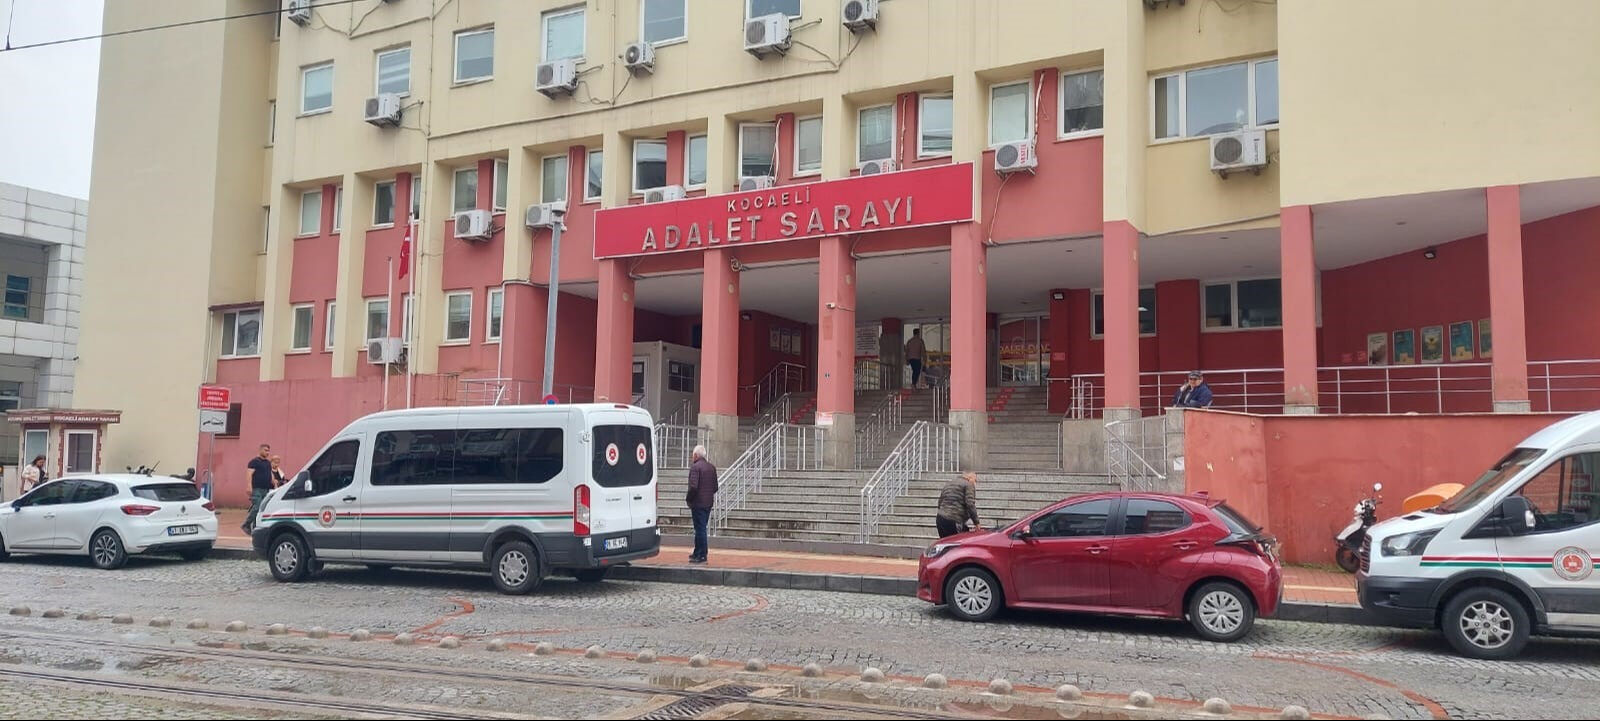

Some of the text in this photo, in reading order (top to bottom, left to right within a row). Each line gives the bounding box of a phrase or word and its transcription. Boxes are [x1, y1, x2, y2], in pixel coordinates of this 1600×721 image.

[727, 186, 811, 212] KOCAELİ
[641, 196, 913, 251] ADALET SARAYI
